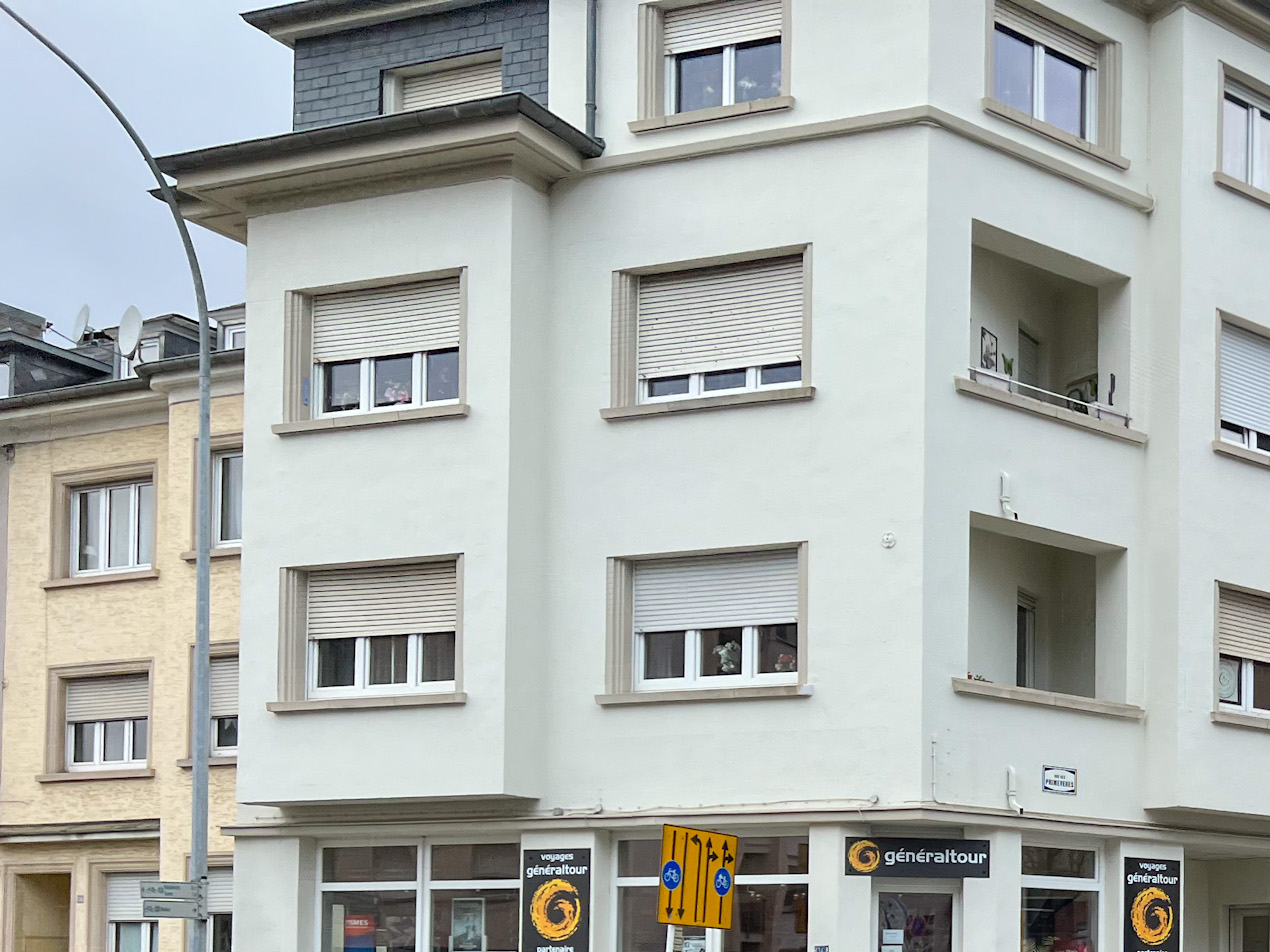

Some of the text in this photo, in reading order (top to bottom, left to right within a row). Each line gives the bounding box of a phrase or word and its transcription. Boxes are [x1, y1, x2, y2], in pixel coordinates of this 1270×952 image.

[540, 853, 574, 863] voyages
[884, 848, 987, 866] généraltour
[526, 864, 588, 878] généraltour
[1138, 862, 1168, 872] voyages
[1126, 872, 1179, 885] généraltour
